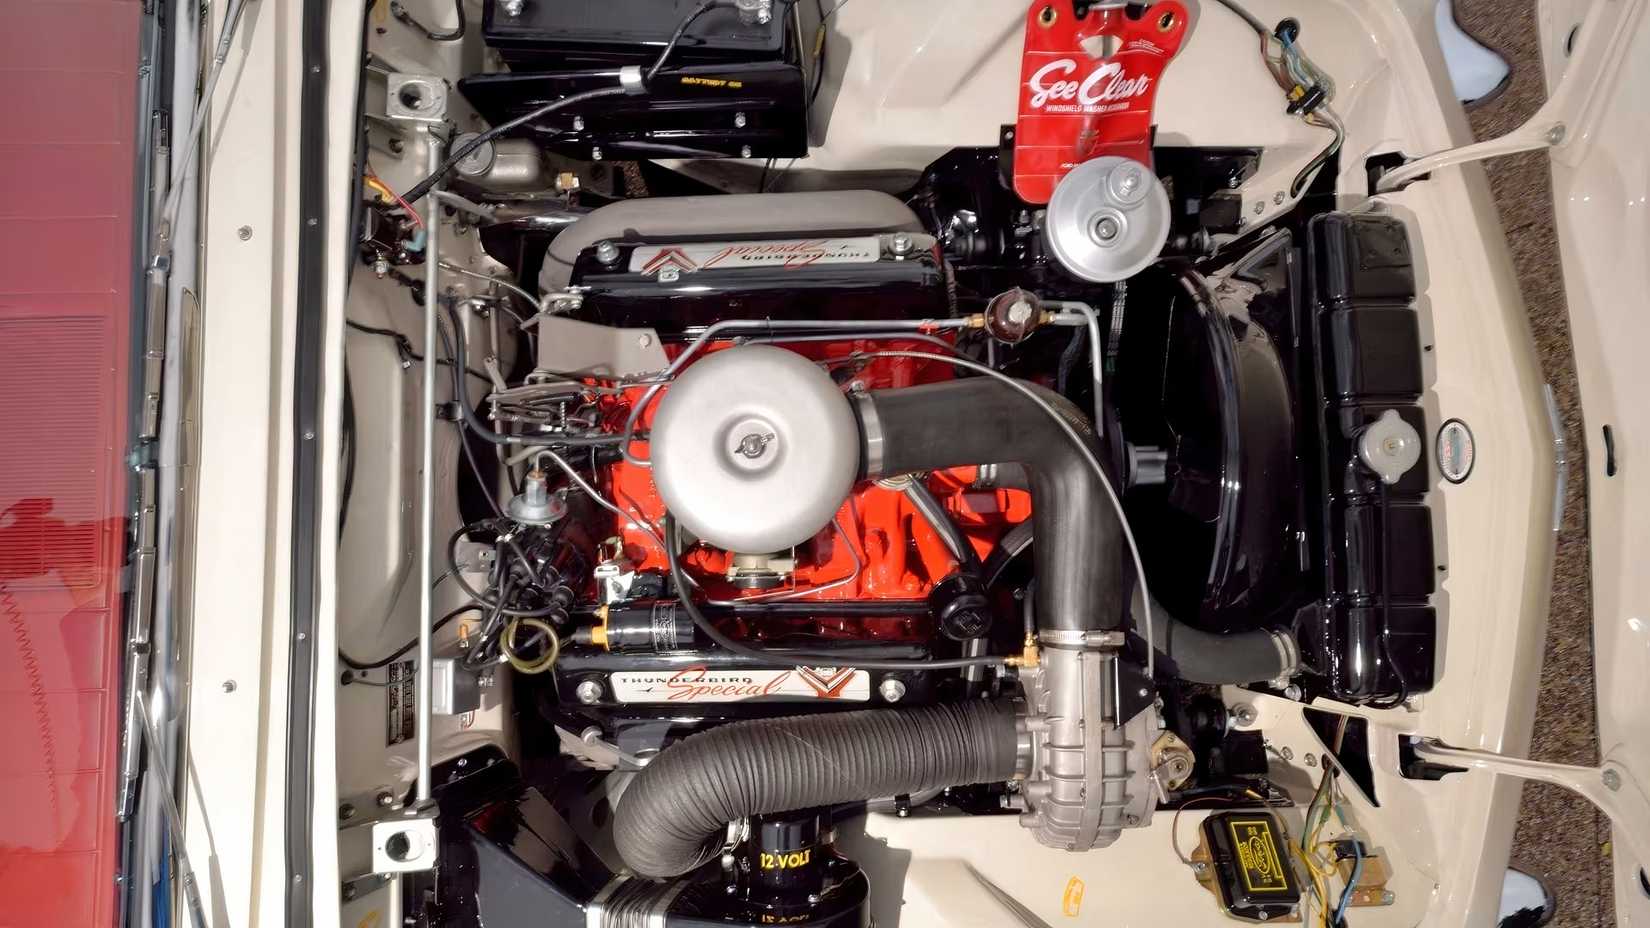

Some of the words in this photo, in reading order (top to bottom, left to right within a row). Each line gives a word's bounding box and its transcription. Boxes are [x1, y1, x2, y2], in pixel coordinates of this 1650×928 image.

[1030, 58, 1079, 108] See
[1078, 62, 1149, 105] Clear
[1046, 104, 1082, 112] WINDSHIELD
[667, 665, 791, 700] Special
[760, 853, 775, 869] 12
[777, 849, 811, 869] VOLT
